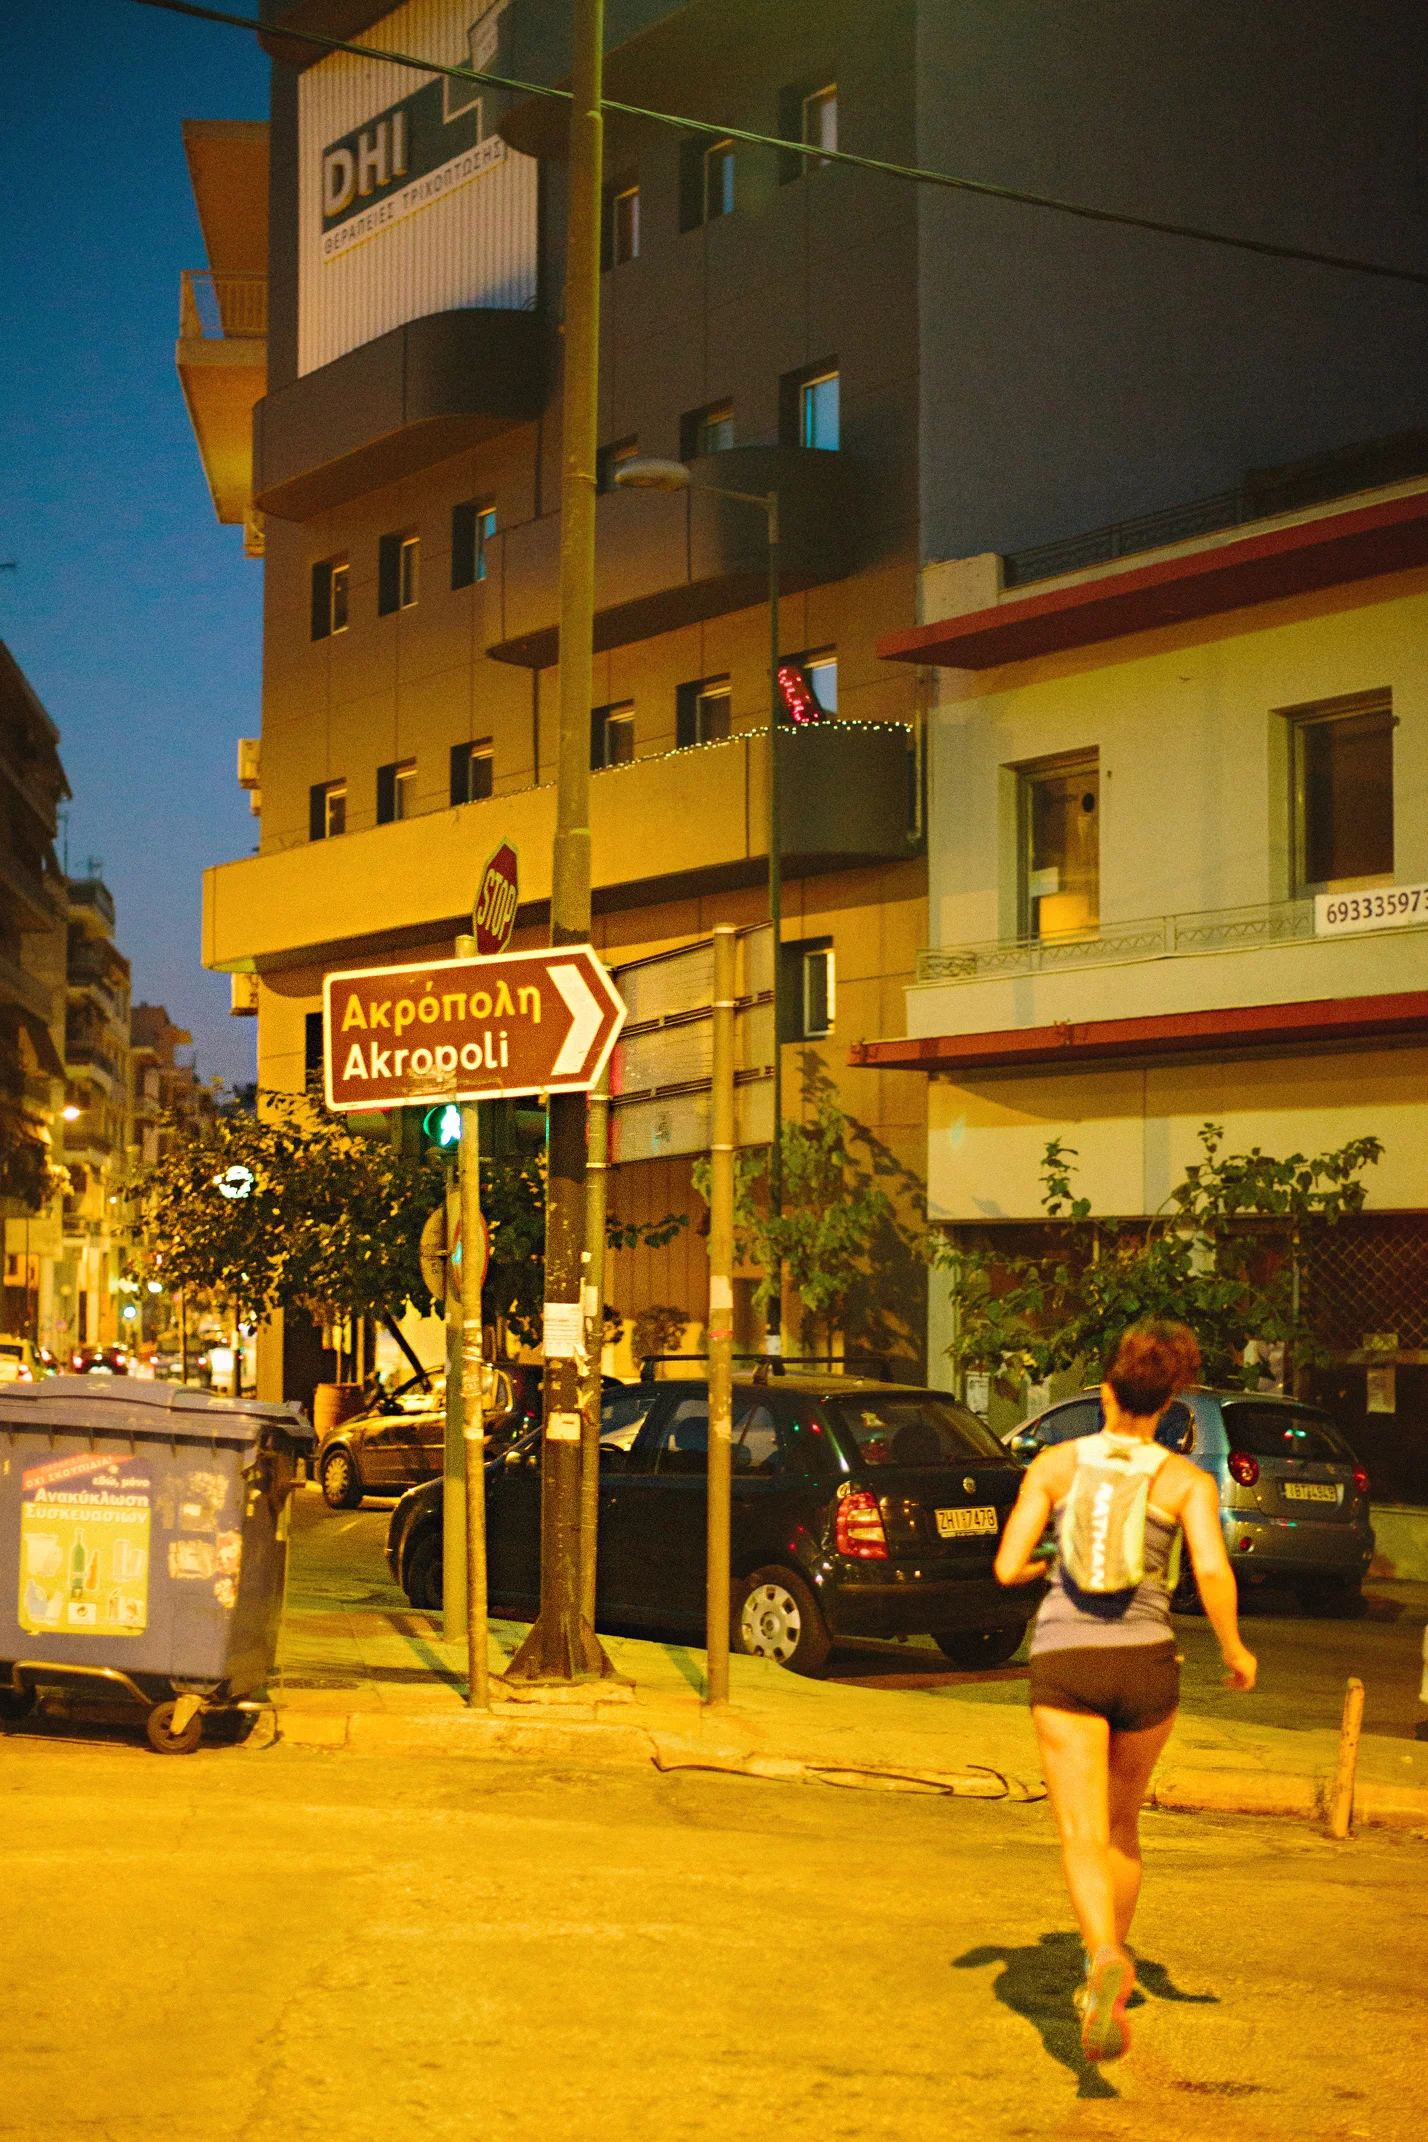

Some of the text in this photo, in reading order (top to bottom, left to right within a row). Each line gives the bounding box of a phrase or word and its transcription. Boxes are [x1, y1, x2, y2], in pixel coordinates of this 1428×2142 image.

[324, 111, 408, 216] DHI
[477, 868, 517, 940] STOP
[341, 980, 542, 1037] Ακρόπολη
[342, 1031, 510, 1081] Akropoli
[34, 1488, 149, 1507] Ανακύκλωση
[121, 1476, 150, 1488] μόνο
[25, 1504, 148, 1524] Συσκευασιών
[1090, 1481, 1114, 1590] NATHAN
